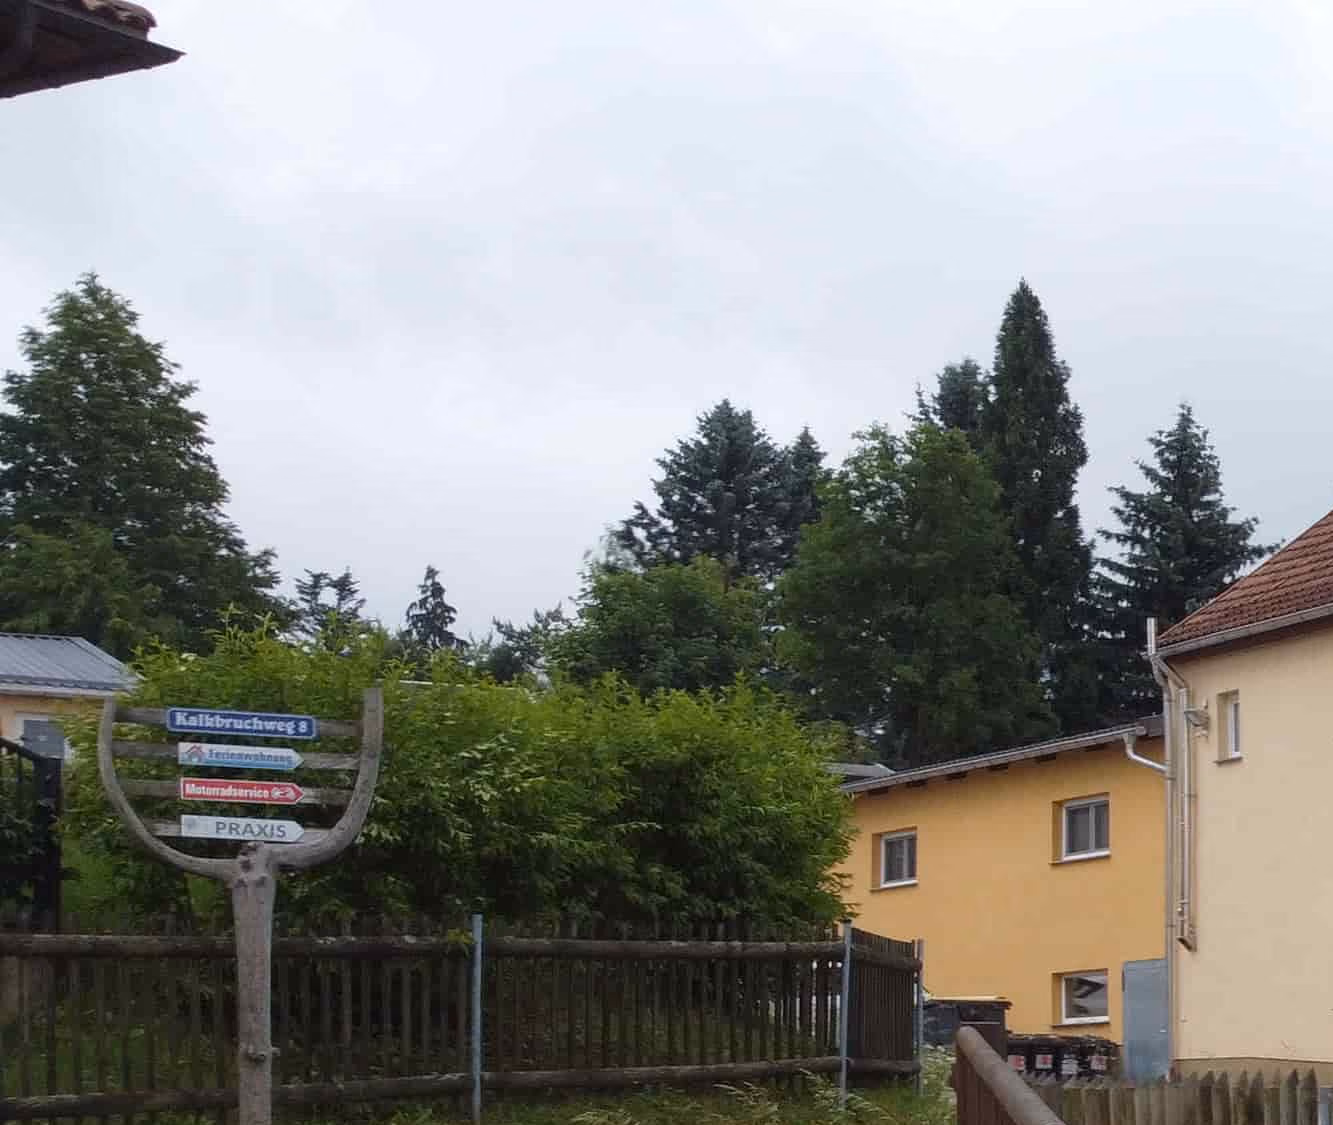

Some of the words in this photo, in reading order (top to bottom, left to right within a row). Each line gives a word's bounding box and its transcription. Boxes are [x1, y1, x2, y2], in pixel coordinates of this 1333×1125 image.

[175, 711, 296, 735] Kalkbruchweg
[299, 721, 307, 733] 8
[185, 783, 269, 798] Motorradservice
[215, 821, 287, 838] PRAXIS
